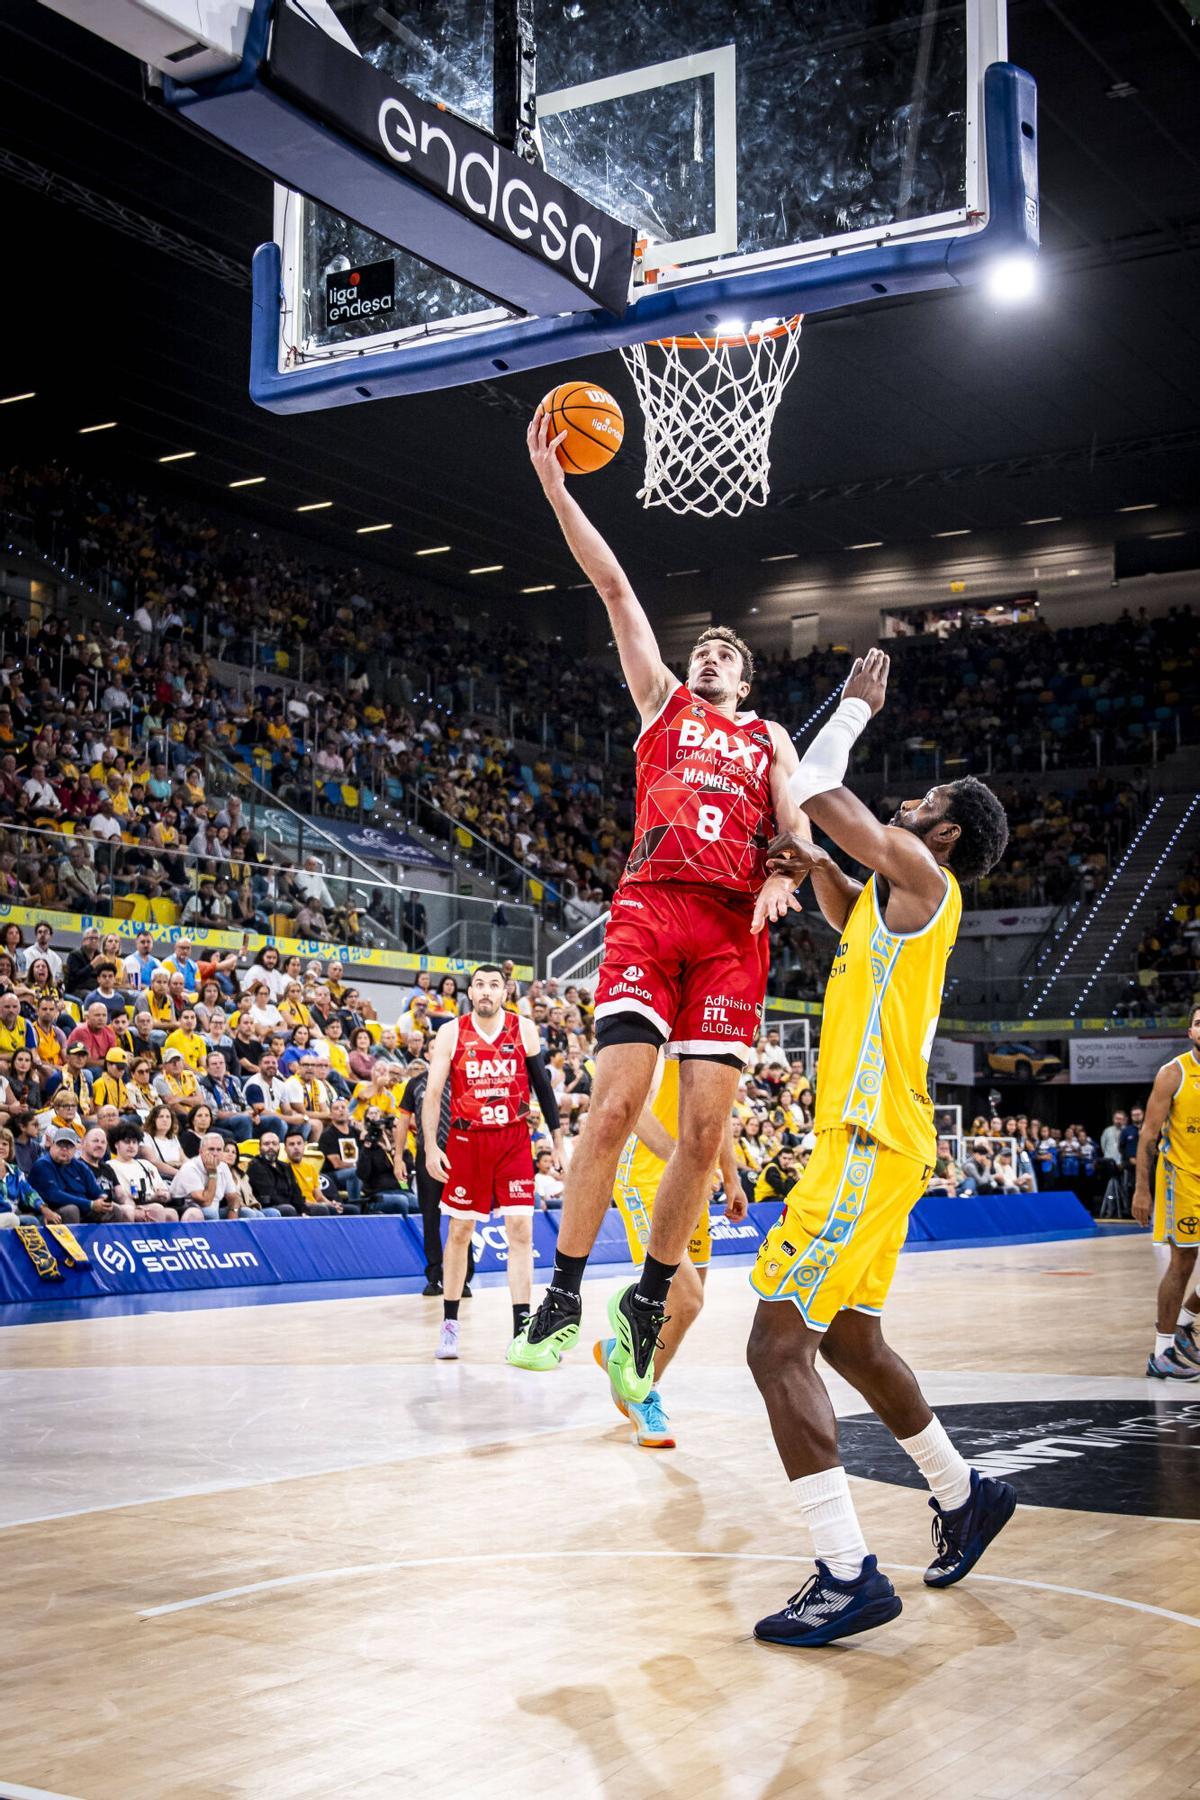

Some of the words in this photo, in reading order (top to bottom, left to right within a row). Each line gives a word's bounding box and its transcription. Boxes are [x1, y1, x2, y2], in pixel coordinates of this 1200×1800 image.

[377, 97, 602, 290] endesa
[329, 286, 357, 305] liga
[329, 295, 392, 321] endesa
[677, 719, 769, 779] BAXI
[682, 767, 747, 801] MANRESA
[696, 804, 724, 842] 8
[704, 994, 752, 1012] Adbisio
[703, 1007, 729, 1022] ETL
[701, 1021, 748, 1037] GLOBAL
[465, 1059, 517, 1079] BAXI
[474, 1087, 510, 1099] MANRESA
[480, 1104, 510, 1125] 29
[131, 1237, 211, 1253] GRUPO
